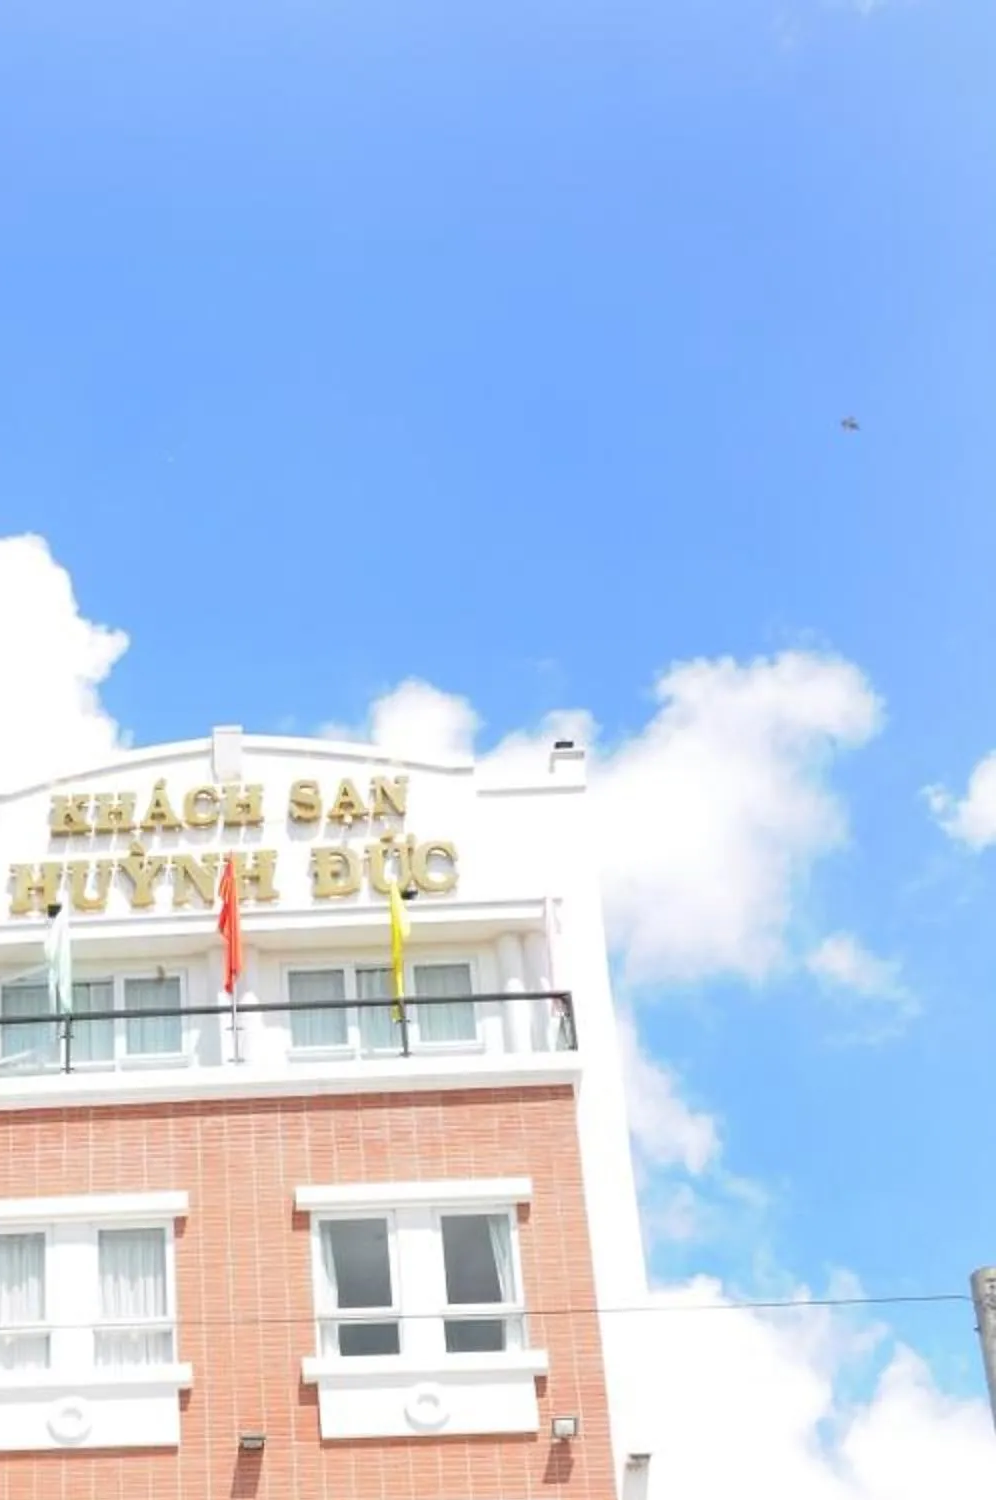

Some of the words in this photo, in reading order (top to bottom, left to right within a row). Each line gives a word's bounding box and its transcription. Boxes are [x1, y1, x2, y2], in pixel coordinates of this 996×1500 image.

[50, 778, 264, 836] KHÁCH
[9, 841, 279, 914] HUỲNH
[309, 831, 460, 898] ĐỨC
